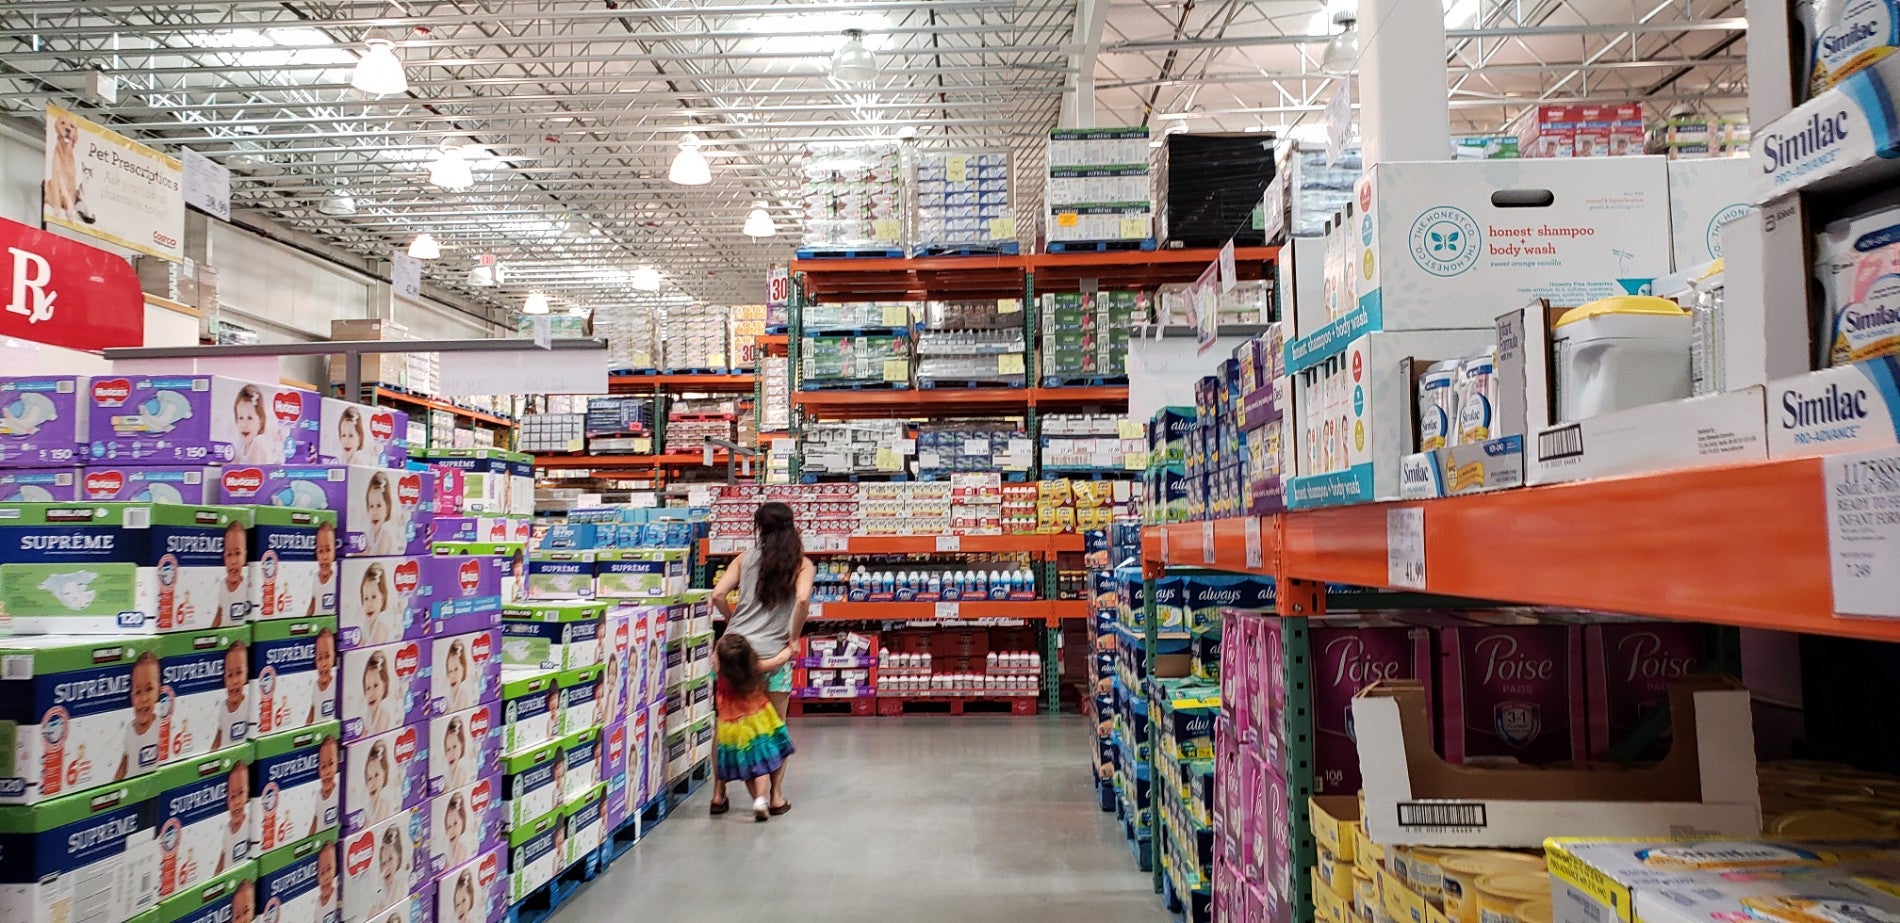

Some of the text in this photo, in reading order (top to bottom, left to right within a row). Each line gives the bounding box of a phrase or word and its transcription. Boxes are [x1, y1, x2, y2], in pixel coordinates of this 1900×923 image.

[1823, 20, 1878, 58] Similac
[1763, 111, 1848, 174] Similac
[88, 142, 109, 162] Pet
[1415, 221, 1427, 238] THE
[1426, 211, 1466, 223] HONEST
[1489, 225, 1595, 238] honest shampoo
[1464, 244, 1476, 261] THE
[1490, 243, 1556, 257] body wash
[1425, 260, 1464, 272] HONEST
[773, 278, 787, 300] 30
[1308, 333, 1331, 350] shampoo
[1336, 320, 1350, 338] body
[1350, 310, 1368, 327] wash
[743, 345, 754, 361] 30
[1783, 383, 1867, 430] Similac
[1171, 419, 1199, 431] alwa
[51, 449, 73, 460] 150
[186, 447, 207, 458] 150
[1403, 462, 1428, 482] Similac
[1171, 478, 1187, 490] alw
[21, 532, 114, 550] SUPRÊME
[167, 532, 224, 553] SUPRÊME
[1135, 587, 1175, 602] aays
[1199, 587, 1241, 602] always
[119, 612, 142, 625] 120
[1325, 635, 1399, 686] Poise
[1475, 634, 1552, 686] Poise
[1619, 632, 1697, 683] Poise
[54, 673, 130, 704] SUPRÊME
[1187, 718, 1209, 731] alw
[1325, 770, 1343, 781] 108
